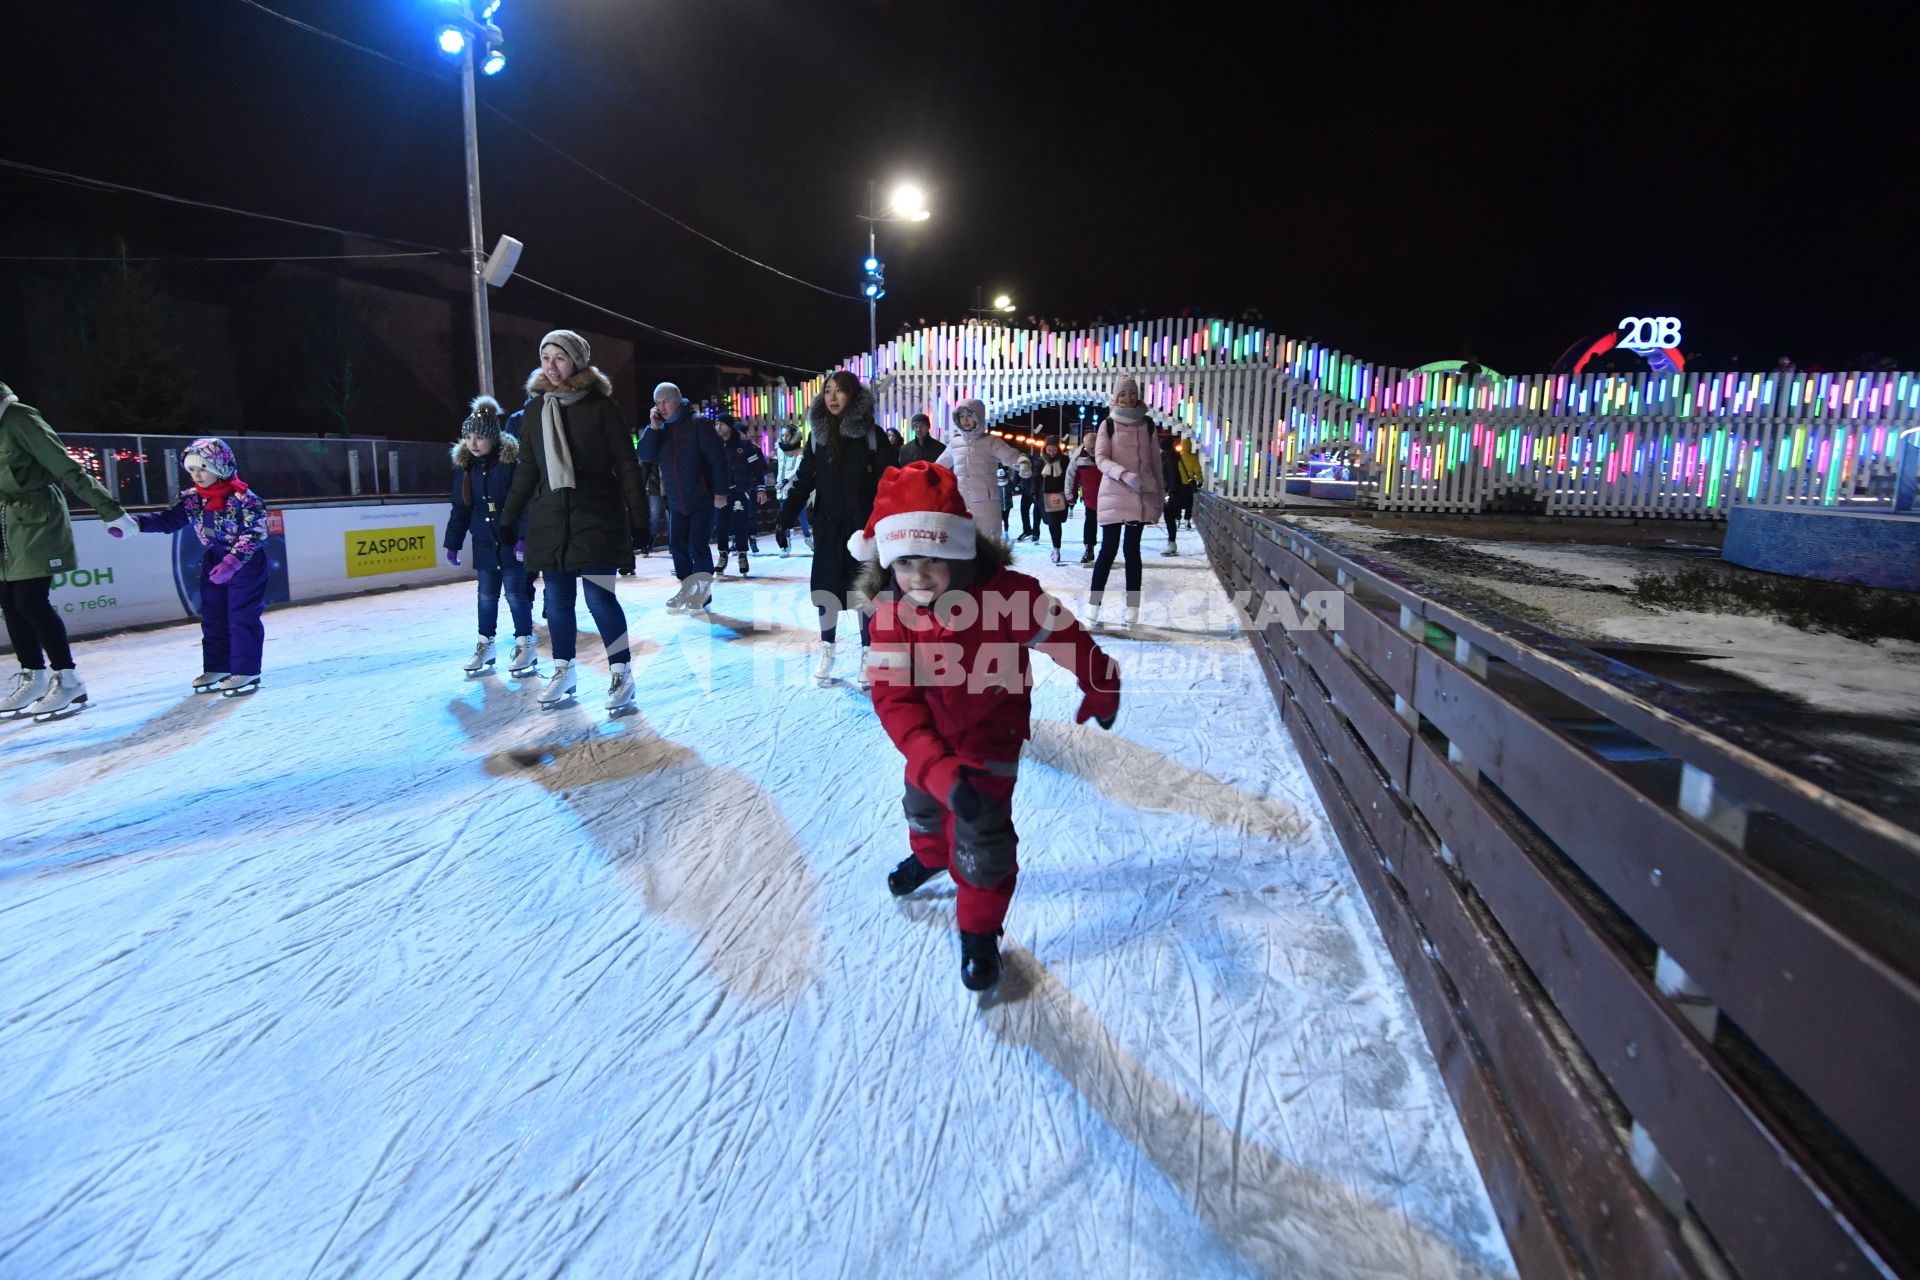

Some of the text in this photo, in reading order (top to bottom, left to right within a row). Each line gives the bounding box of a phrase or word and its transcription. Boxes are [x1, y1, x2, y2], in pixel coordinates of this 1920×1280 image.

[1616, 316, 1682, 349] 2018
[356, 536, 426, 556] ZASPORT
[64, 603, 74, 613] с
[80, 595, 117, 611] тебя
